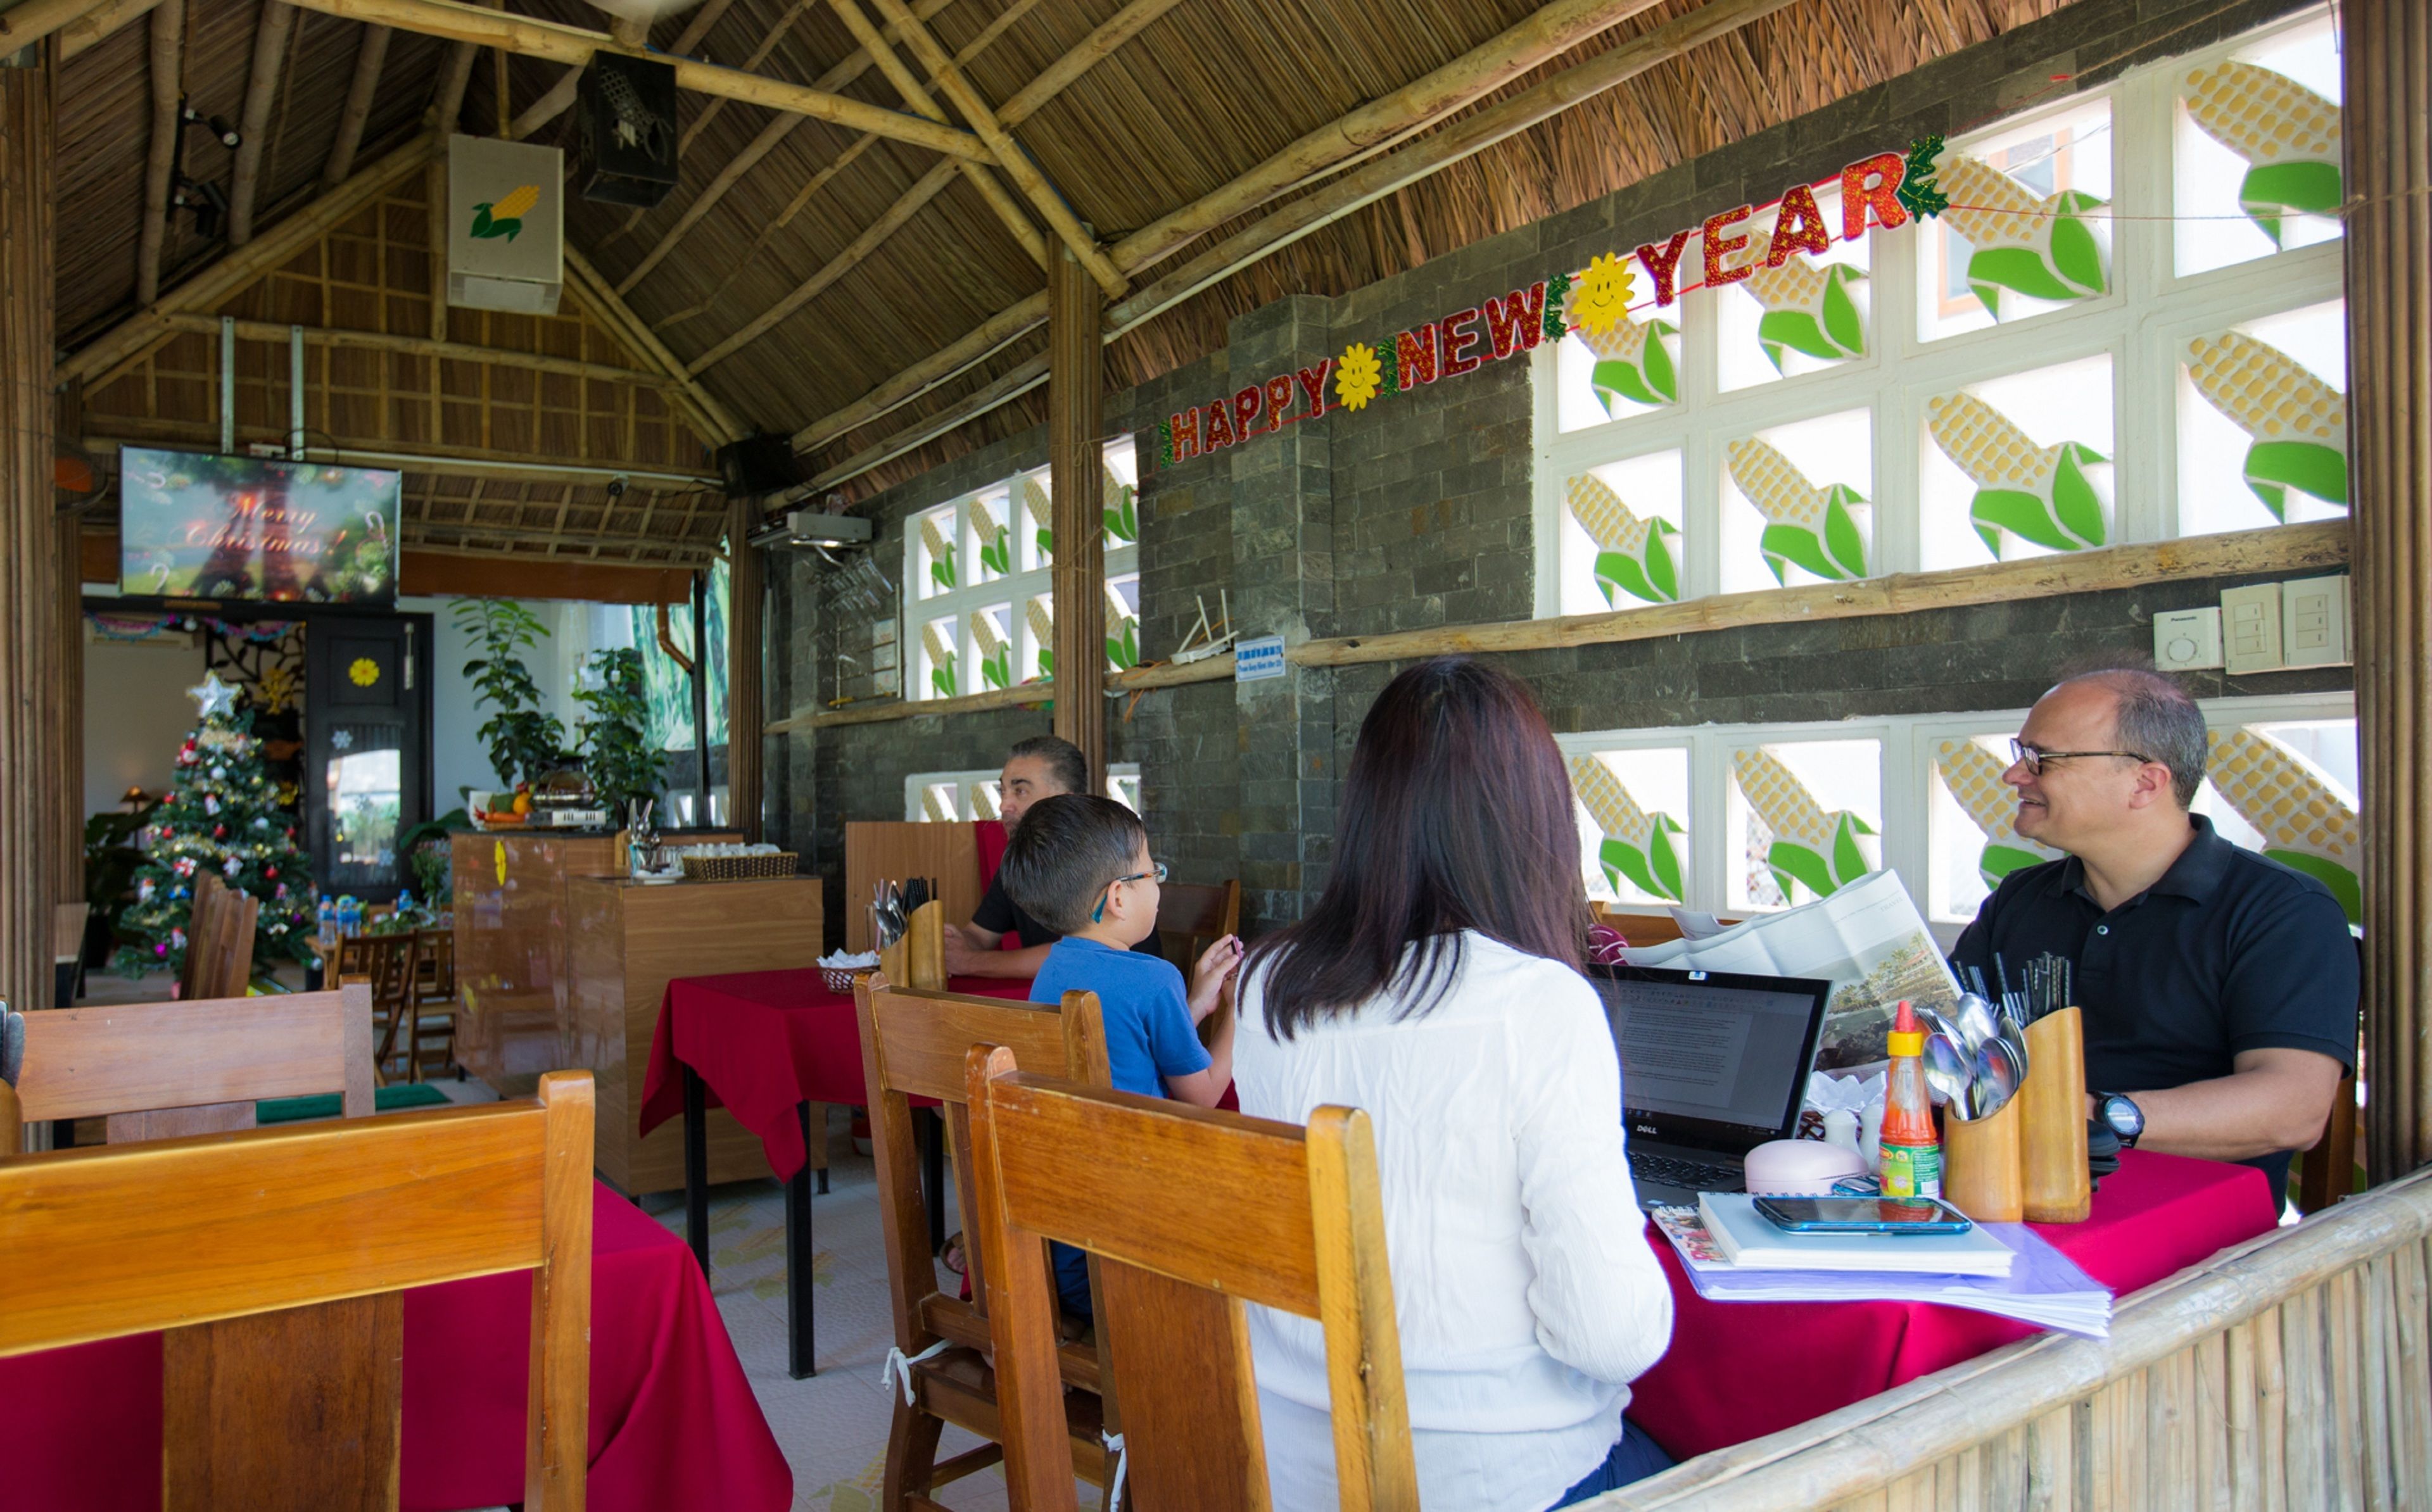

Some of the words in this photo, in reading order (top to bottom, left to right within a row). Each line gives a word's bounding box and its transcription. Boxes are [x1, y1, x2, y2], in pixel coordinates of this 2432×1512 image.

[1171, 357, 1331, 463] HAPPY
[1396, 281, 1545, 391] NEW
[1635, 152, 1912, 308] YEAR
[227, 490, 315, 534] Merry
[1637, 1125, 1657, 1134] DELL
